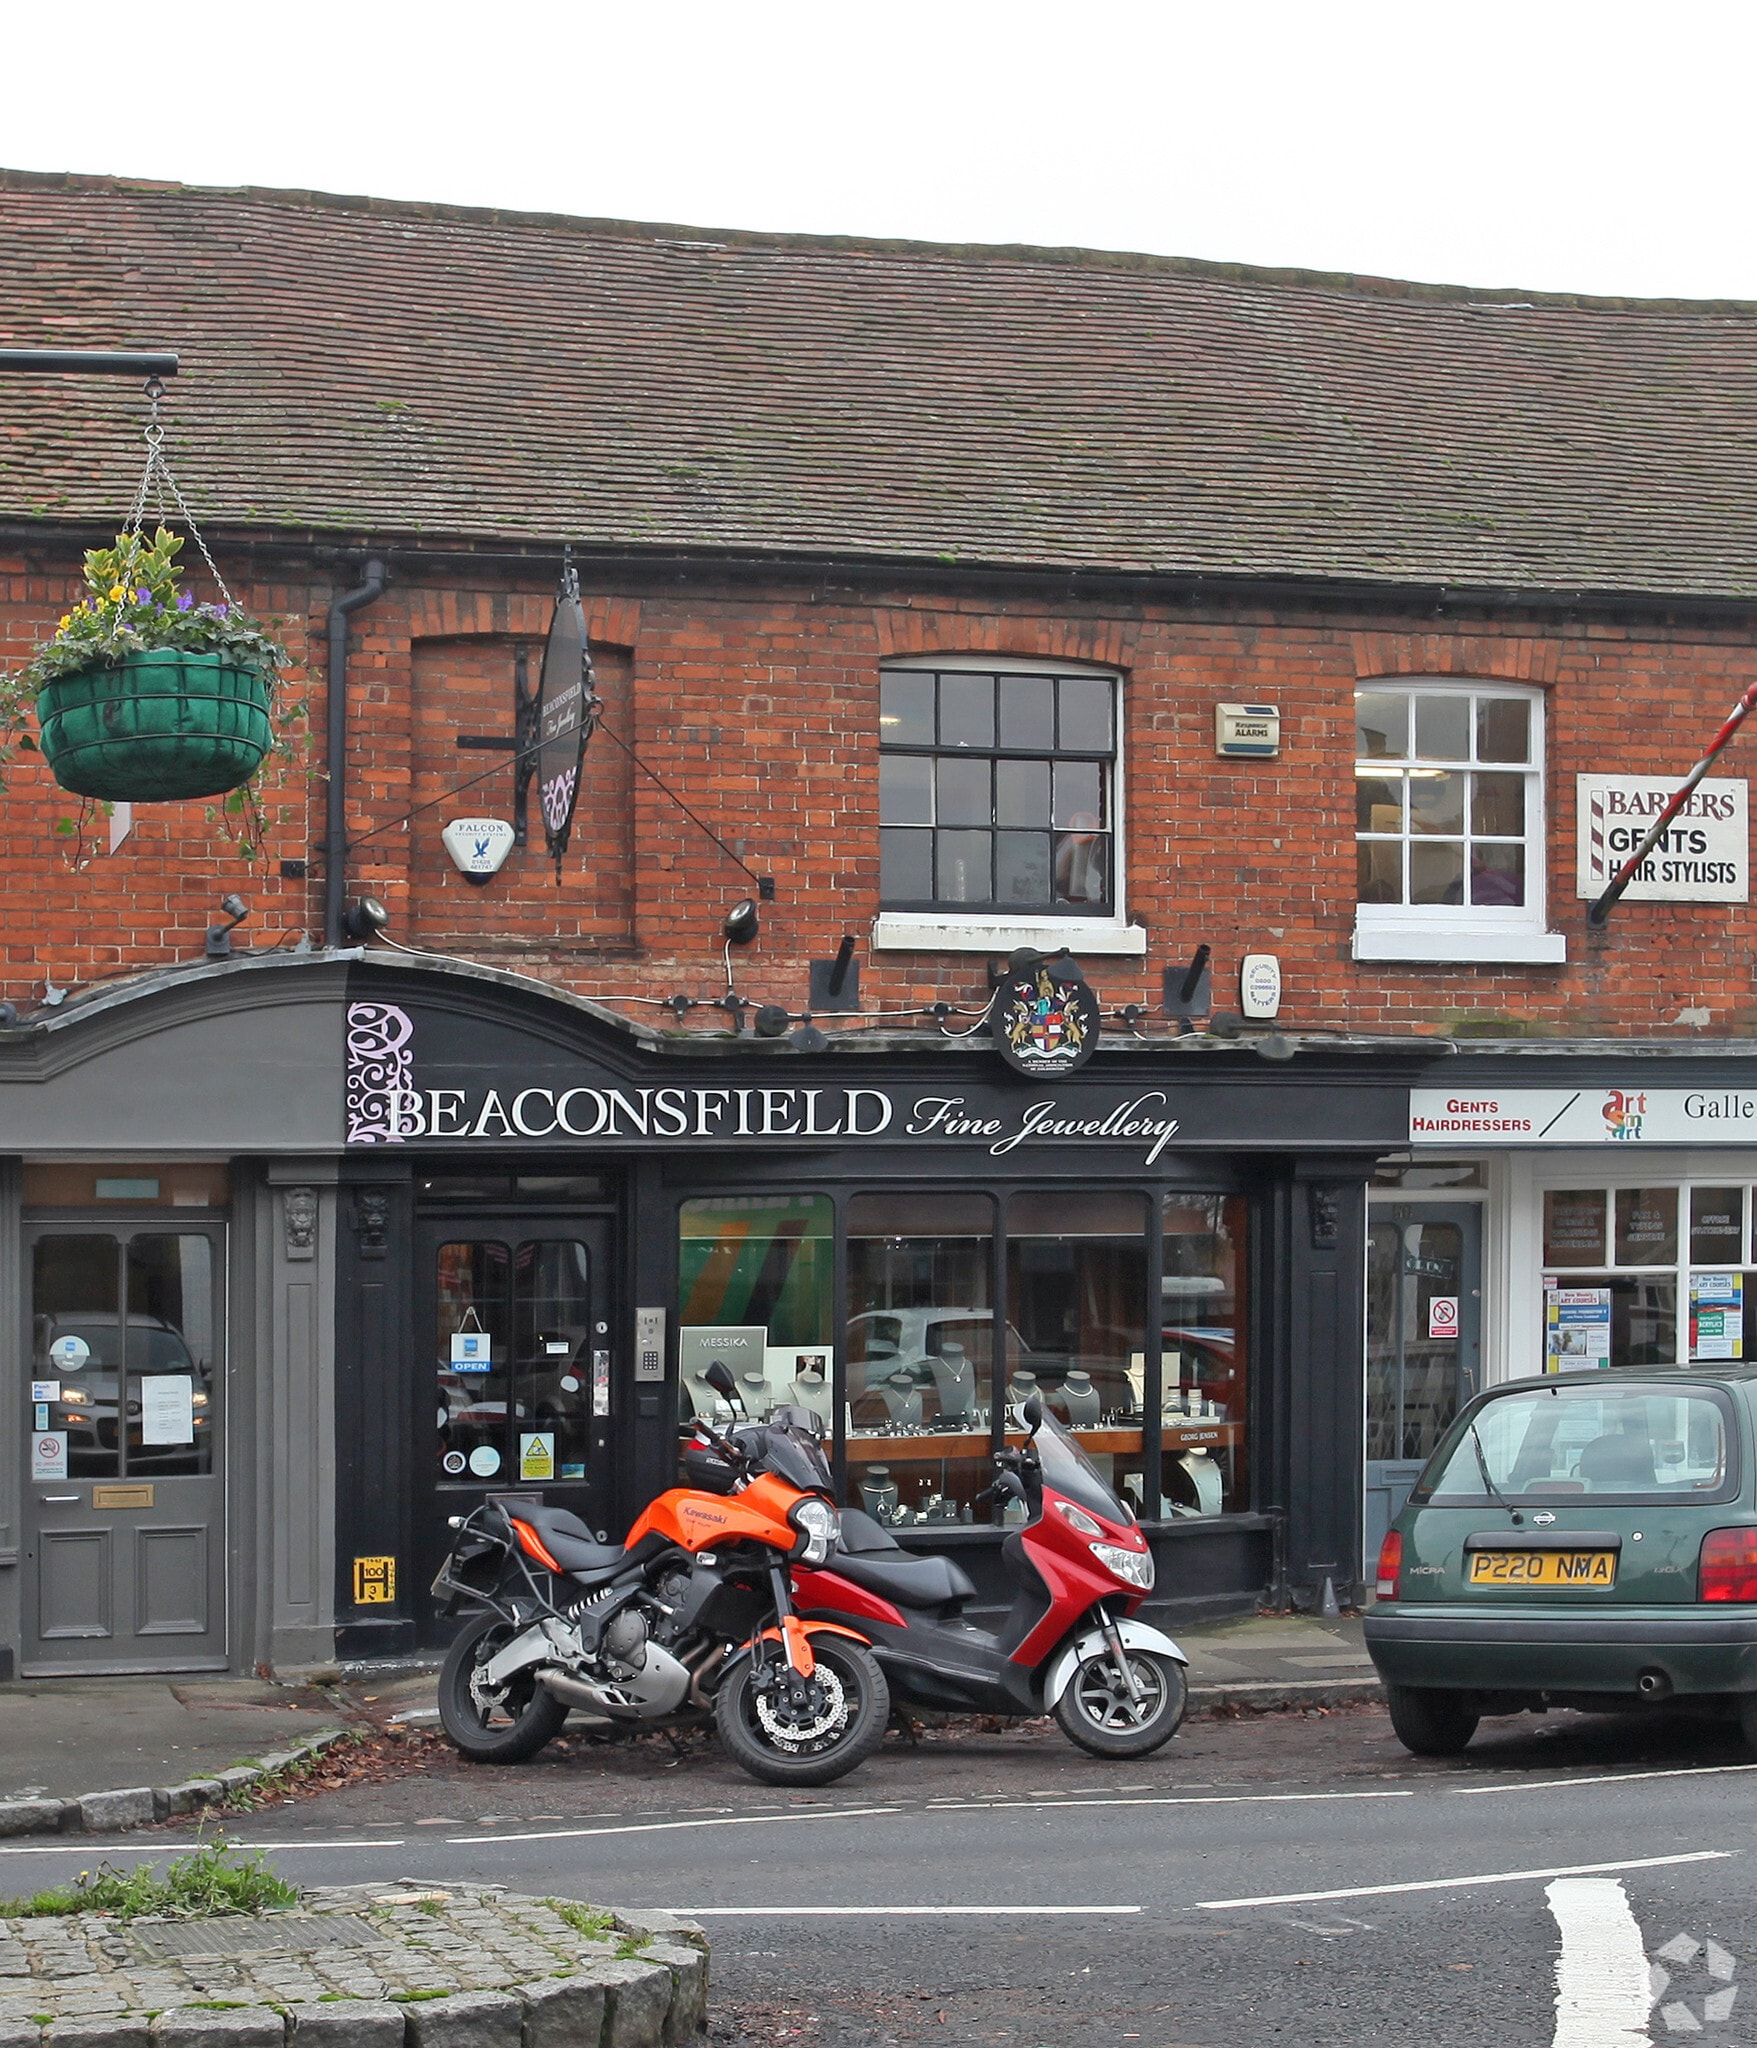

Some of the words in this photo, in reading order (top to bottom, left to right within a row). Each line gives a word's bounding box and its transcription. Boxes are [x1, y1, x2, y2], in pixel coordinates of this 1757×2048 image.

[1235, 729, 1268, 737] ALARMS
[1609, 860, 1656, 882] HIR
[1662, 861, 1737, 884] STYLISTS
[1250, 963, 1277, 979] SECURITY
[1250, 991, 1276, 1007] MATTERS
[1684, 1093, 1757, 1119] Galle
[387, 1087, 894, 1137] BEACONSFIELD
[904, 1096, 1004, 1136] Fine
[989, 1091, 1180, 1166] Jewellery
[699, 1338, 748, 1347] MESSIKA
[454, 1363, 487, 1371] OPEN
[683, 1507, 728, 1524] Kawasaki
[365, 1567, 384, 1577] 100
[1473, 1556, 1543, 1578] P220
[1556, 1556, 1608, 1579] NMA
[369, 1585, 377, 1595] 3
